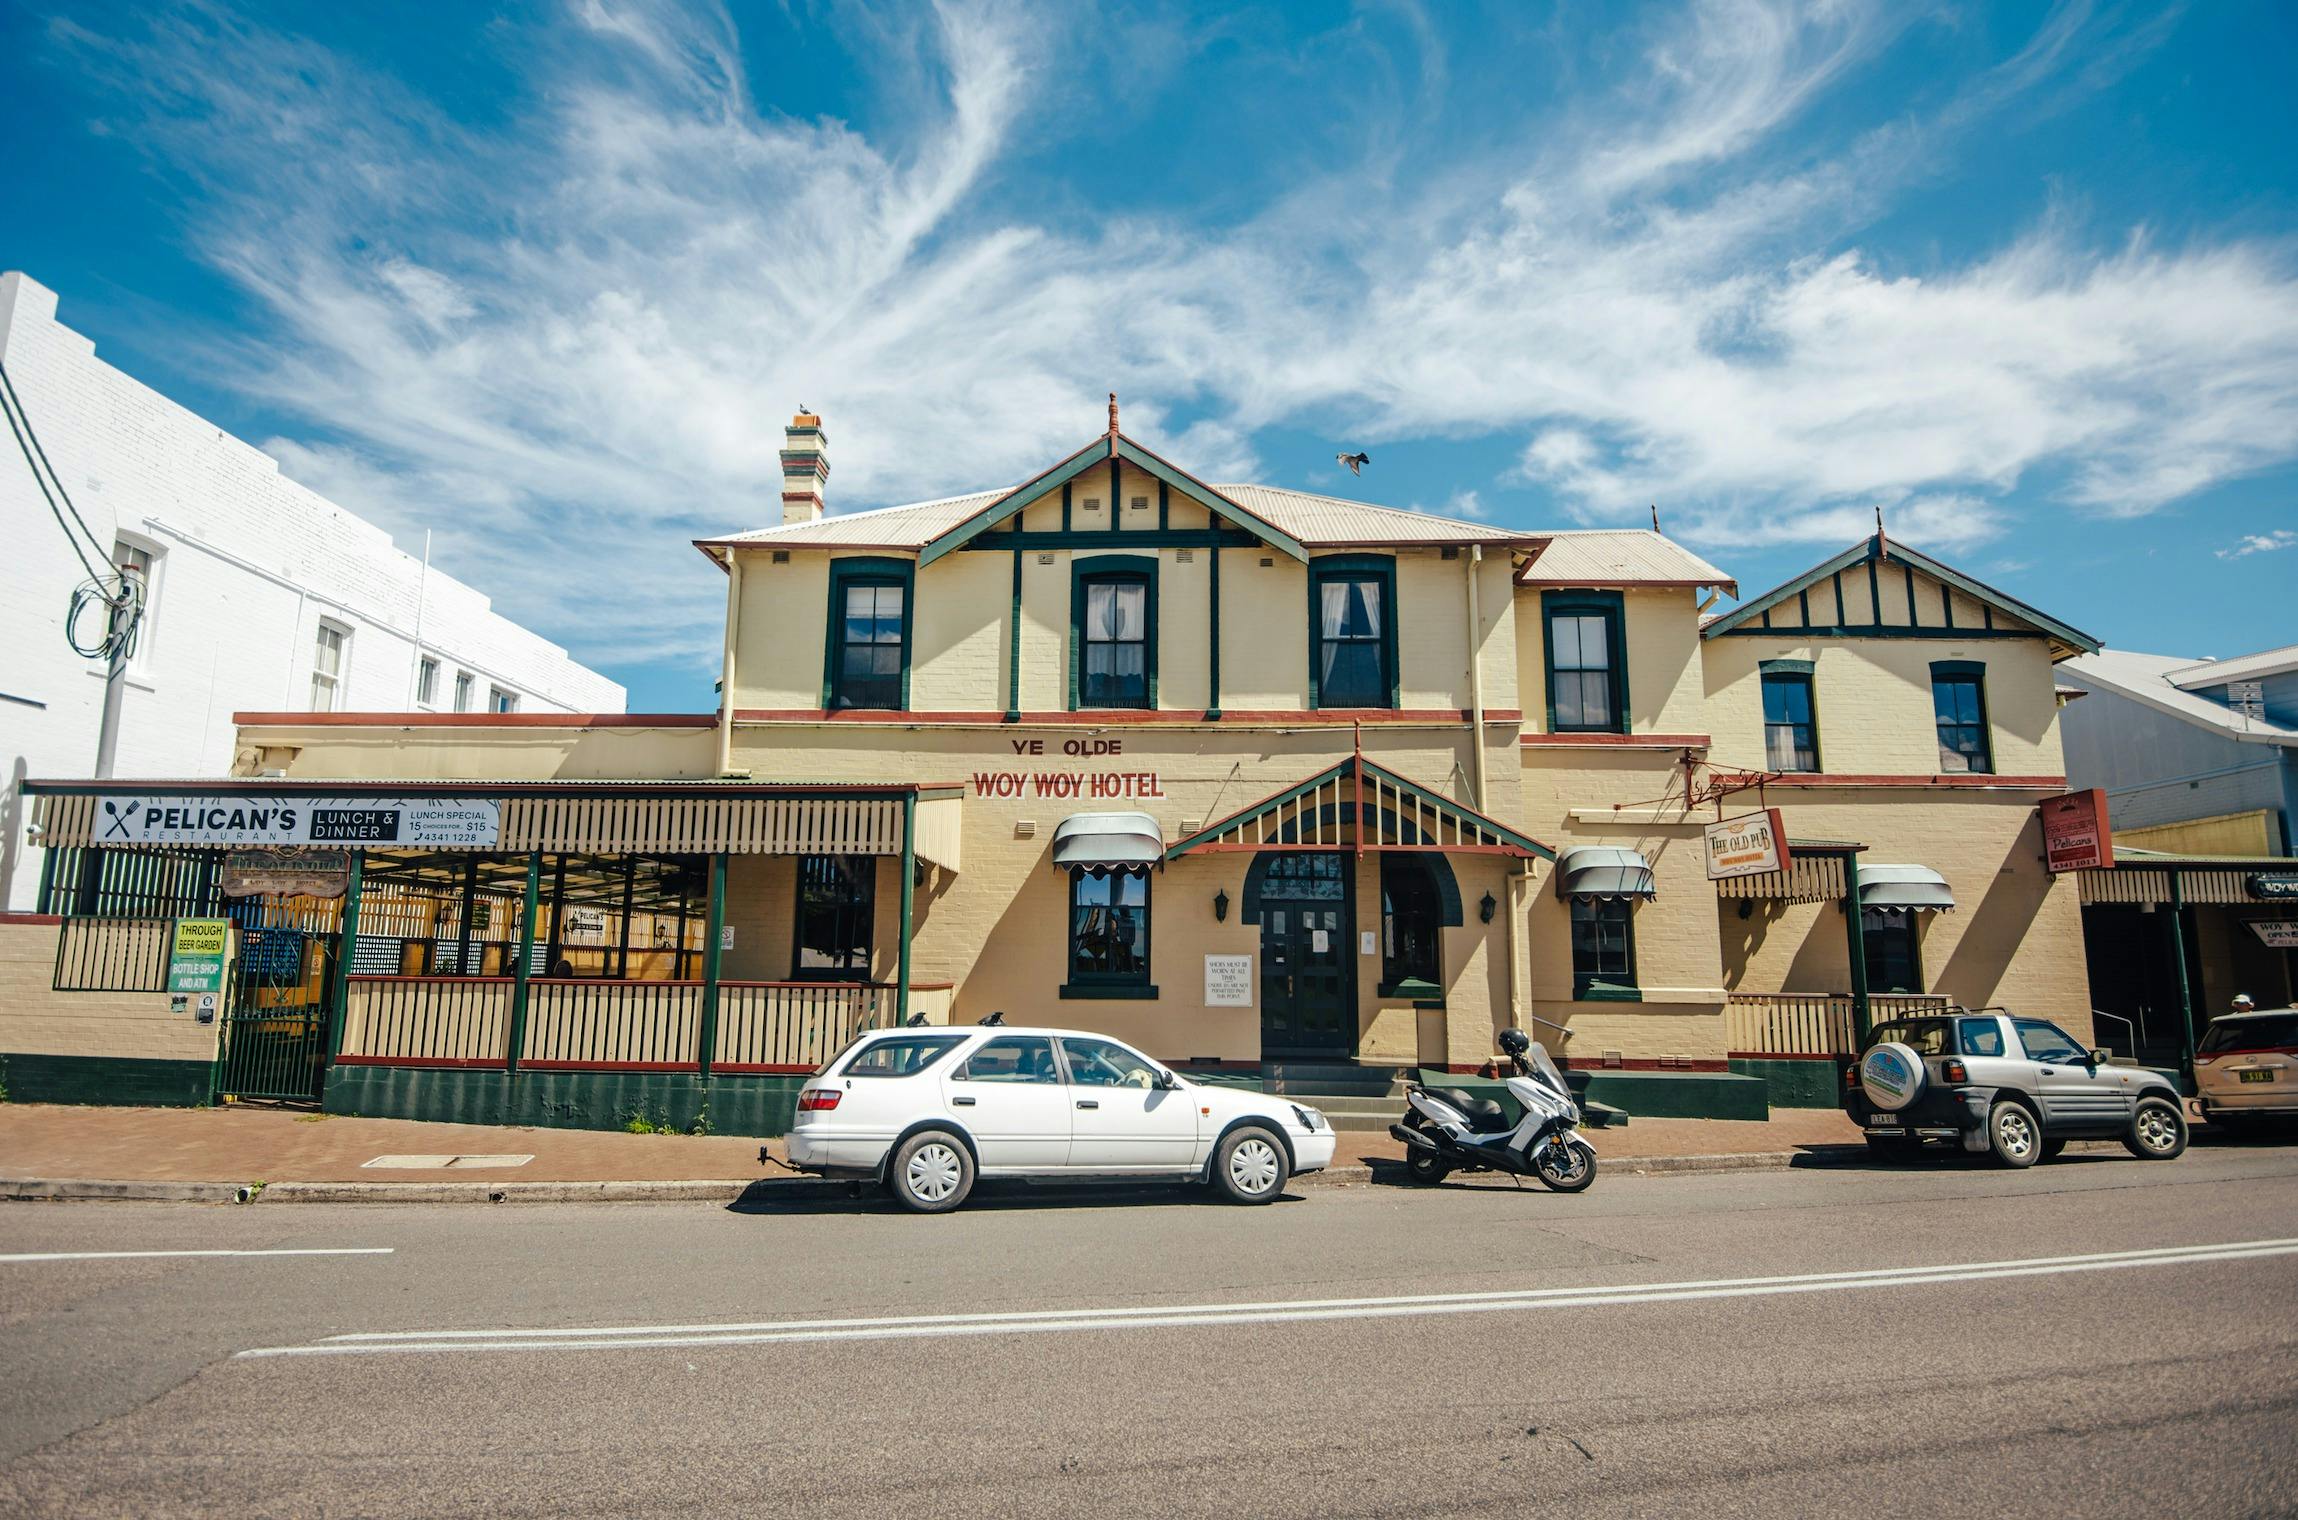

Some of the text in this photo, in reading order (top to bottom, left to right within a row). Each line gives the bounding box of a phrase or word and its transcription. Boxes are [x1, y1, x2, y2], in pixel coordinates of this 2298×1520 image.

[1012, 740, 1122, 755] YE OLDE
[973, 773, 1164, 797] WOY WOY HOTEL
[144, 808, 297, 830] PELICAN'S
[317, 812, 394, 824] LUNCH &
[410, 811, 487, 820] LUNCH SPECIAL
[315, 826, 380, 838] DINNER
[409, 822, 421, 831] 15
[143, 831, 294, 840] RESTAURANT
[424, 833, 477, 842] 4341 1228
[1710, 828, 1771, 858] THE OLD PUB
[2053, 838, 2092, 849] Pelicans
[2054, 861, 2073, 869] 4341
[2265, 883, 2286, 892] WOY
[181, 926, 222, 935] THROUGH
[179, 940, 220, 950] BEER GARDEN
[173, 963, 219, 974] BOTTLE SHOP
[178, 978, 208, 989] AND ATM
